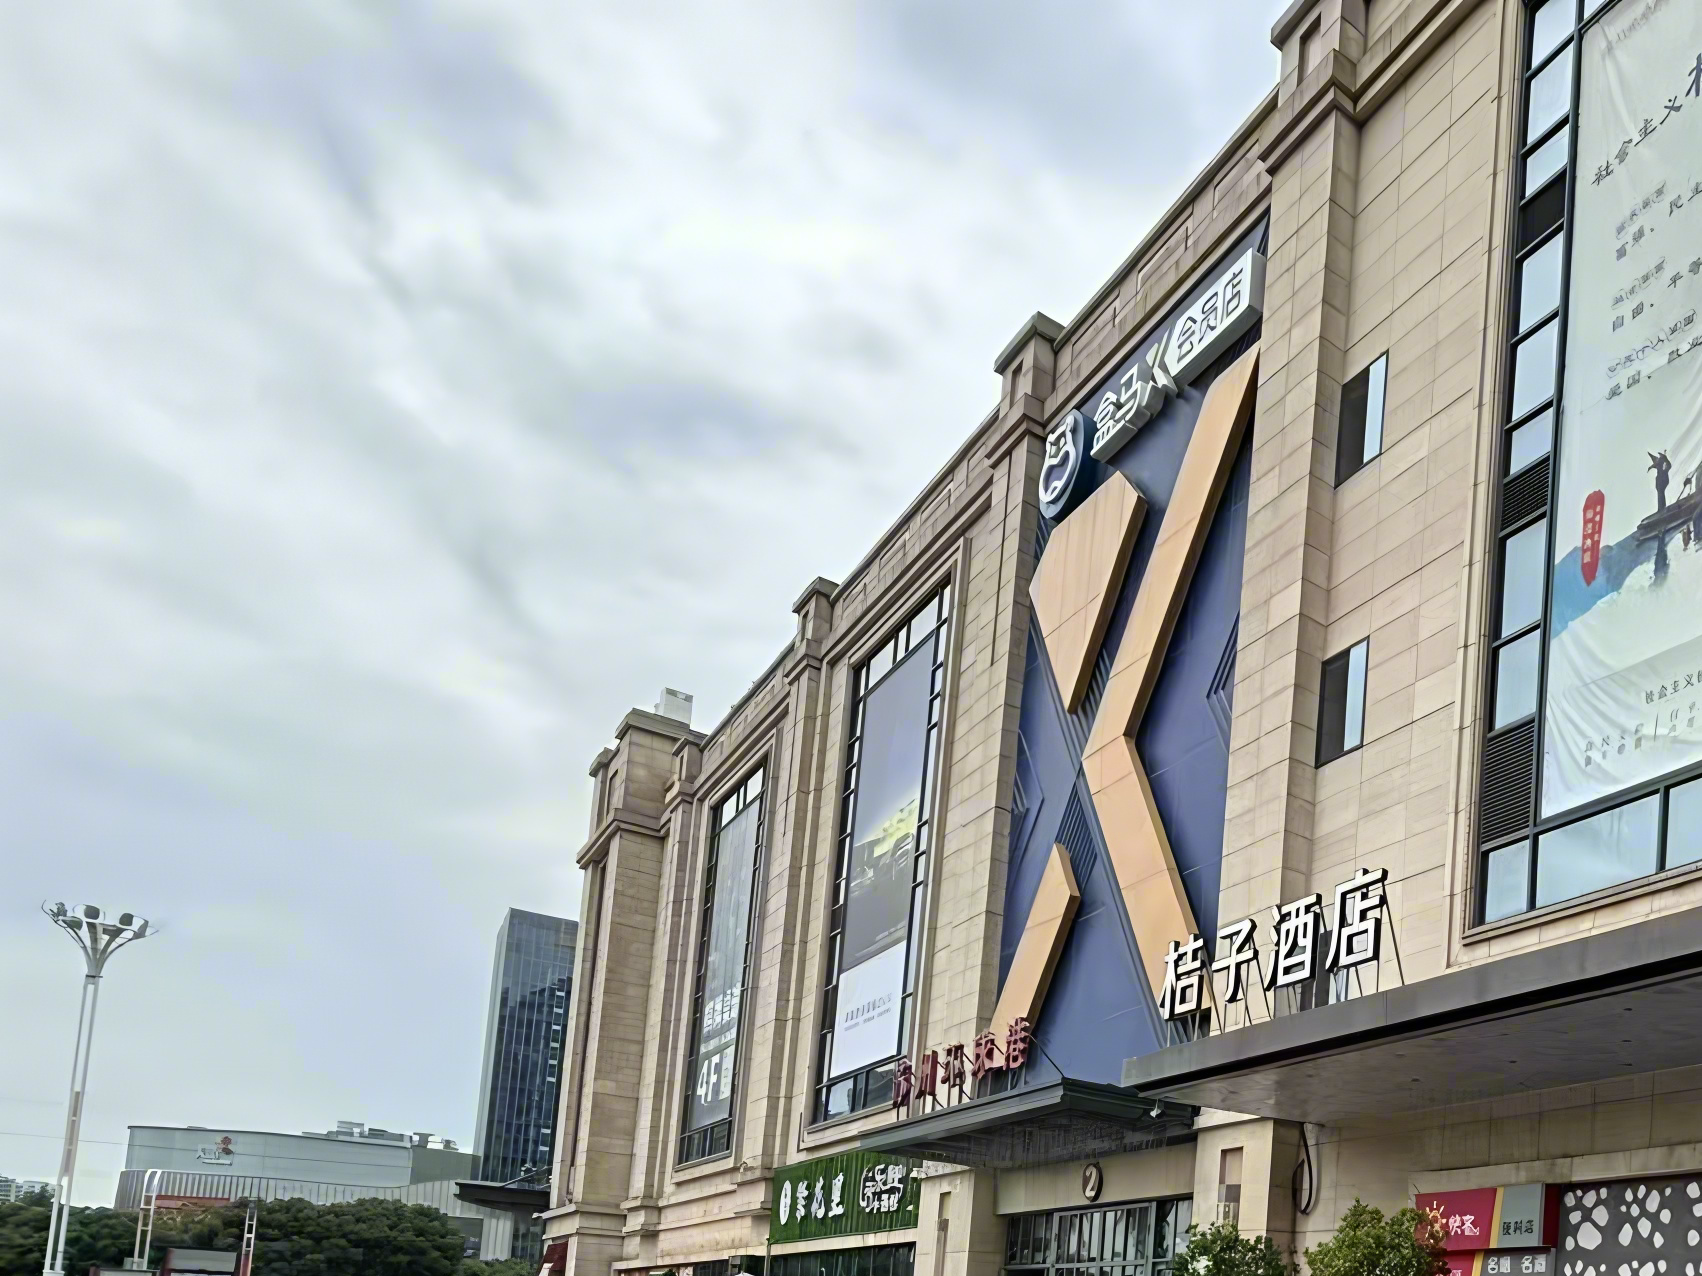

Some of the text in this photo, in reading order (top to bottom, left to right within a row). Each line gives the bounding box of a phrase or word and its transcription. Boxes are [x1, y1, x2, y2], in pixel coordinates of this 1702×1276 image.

[1158, 868, 1389, 1021] 桔子酒店
[1085, 1164, 1097, 1198] 2
